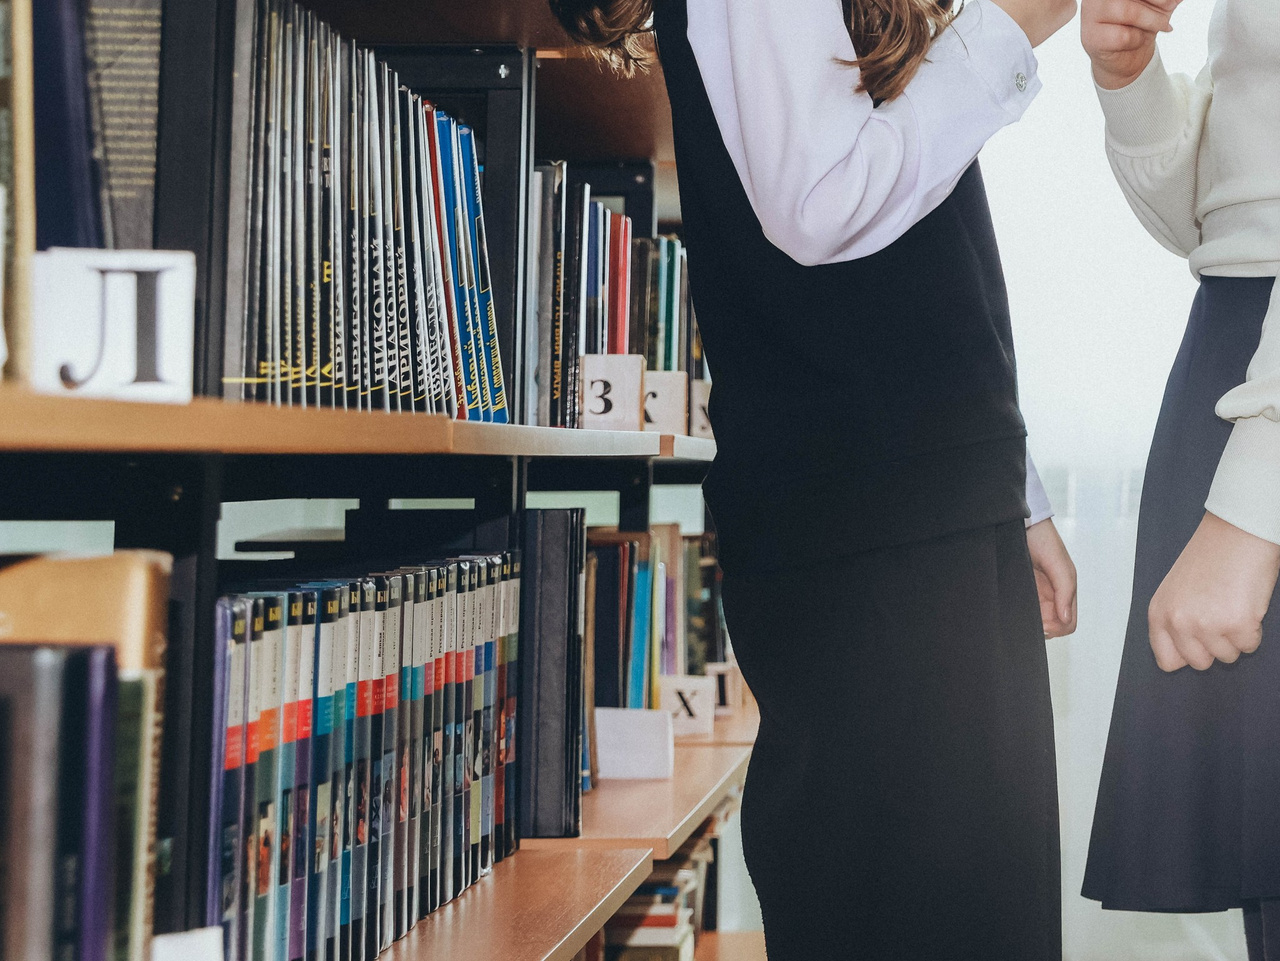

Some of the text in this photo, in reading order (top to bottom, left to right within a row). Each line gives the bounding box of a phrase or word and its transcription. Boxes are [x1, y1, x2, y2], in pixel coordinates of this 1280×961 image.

[59, 266, 178, 390] Л
[370, 237, 386, 384] НИКОЛАЙ
[395, 246, 411, 389] ГРИГОРИЙ
[427, 282, 441, 397] ВЯЧЕСЛАВ
